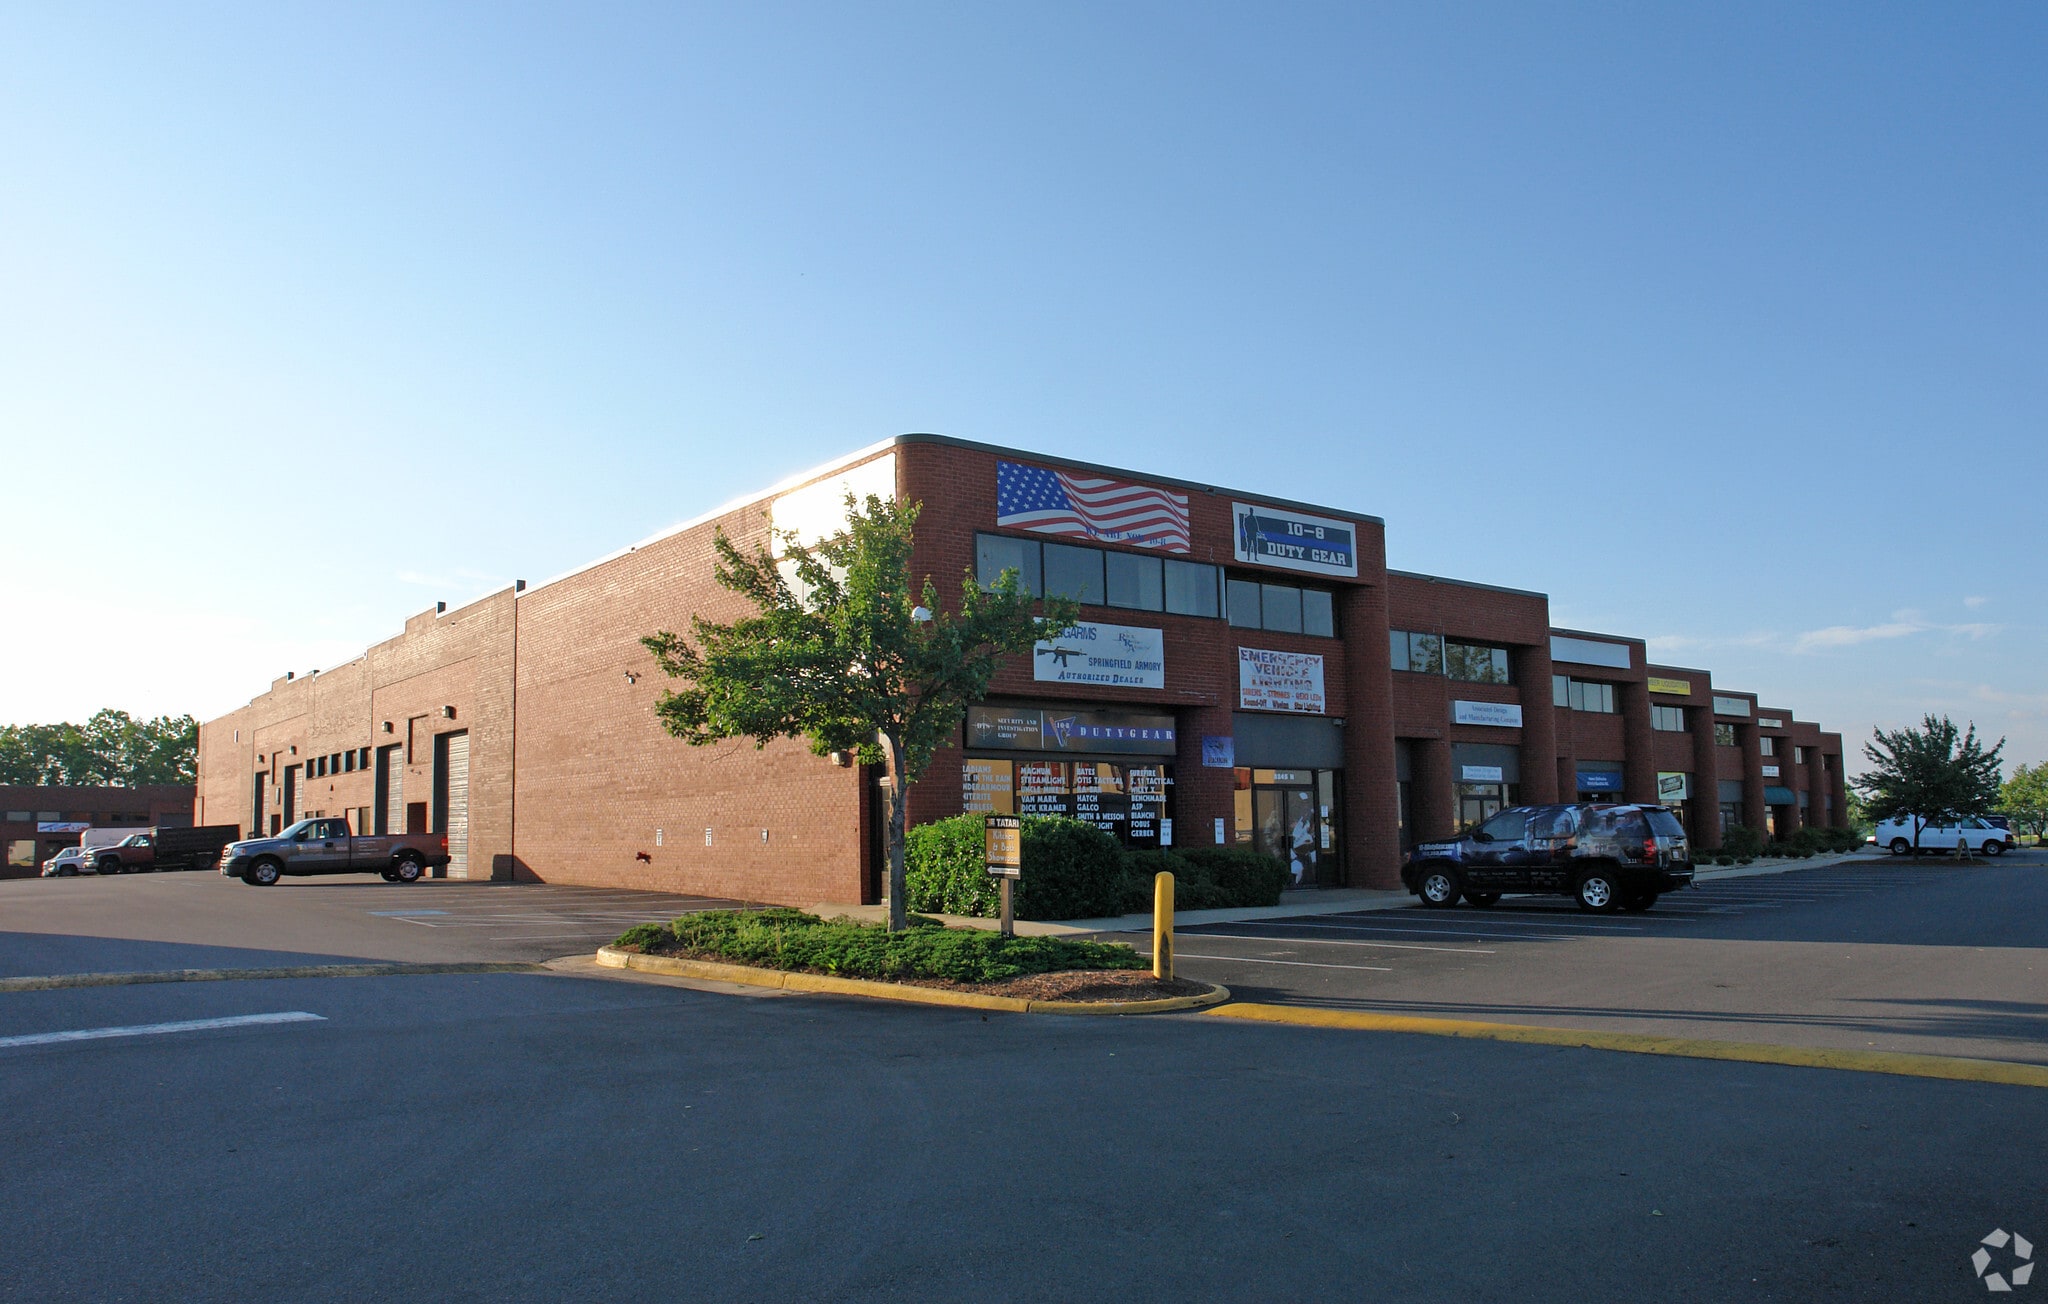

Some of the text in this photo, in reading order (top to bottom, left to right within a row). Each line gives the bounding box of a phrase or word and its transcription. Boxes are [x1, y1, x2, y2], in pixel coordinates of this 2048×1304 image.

[1287, 522, 1325, 540] 10-8
[1267, 541, 1347, 566] DUTY GEAR
[1056, 626, 1097, 641] GARMS
[1088, 657, 1161, 672] SPRINGFIELD ARMORY
[1020, 767, 1052, 776] MAGNUM
[1076, 768, 1096, 777] BATES
[1129, 769, 1156, 778] SUREFIRE
[1020, 776, 1066, 786] STREAMLIGHT
[1076, 777, 1124, 786] OTIS TACTICAL
[1146, 778, 1175, 786] TACTICAL
[1021, 795, 1058, 804] VAN MARK
[1076, 795, 1098, 803] HATCH
[1130, 795, 1167, 803] BENCHMADE
[1021, 804, 1067, 813] DICK KRAMER
[1076, 804, 1100, 813] GALCO
[1131, 803, 1144, 812] ASP
[1076, 813, 1095, 821] SMITH
[1102, 813, 1125, 822] WESSON
[1130, 812, 1156, 821] BIANCHI
[1130, 820, 1151, 830] FOBUS
[1130, 830, 1155, 838] GERBER
